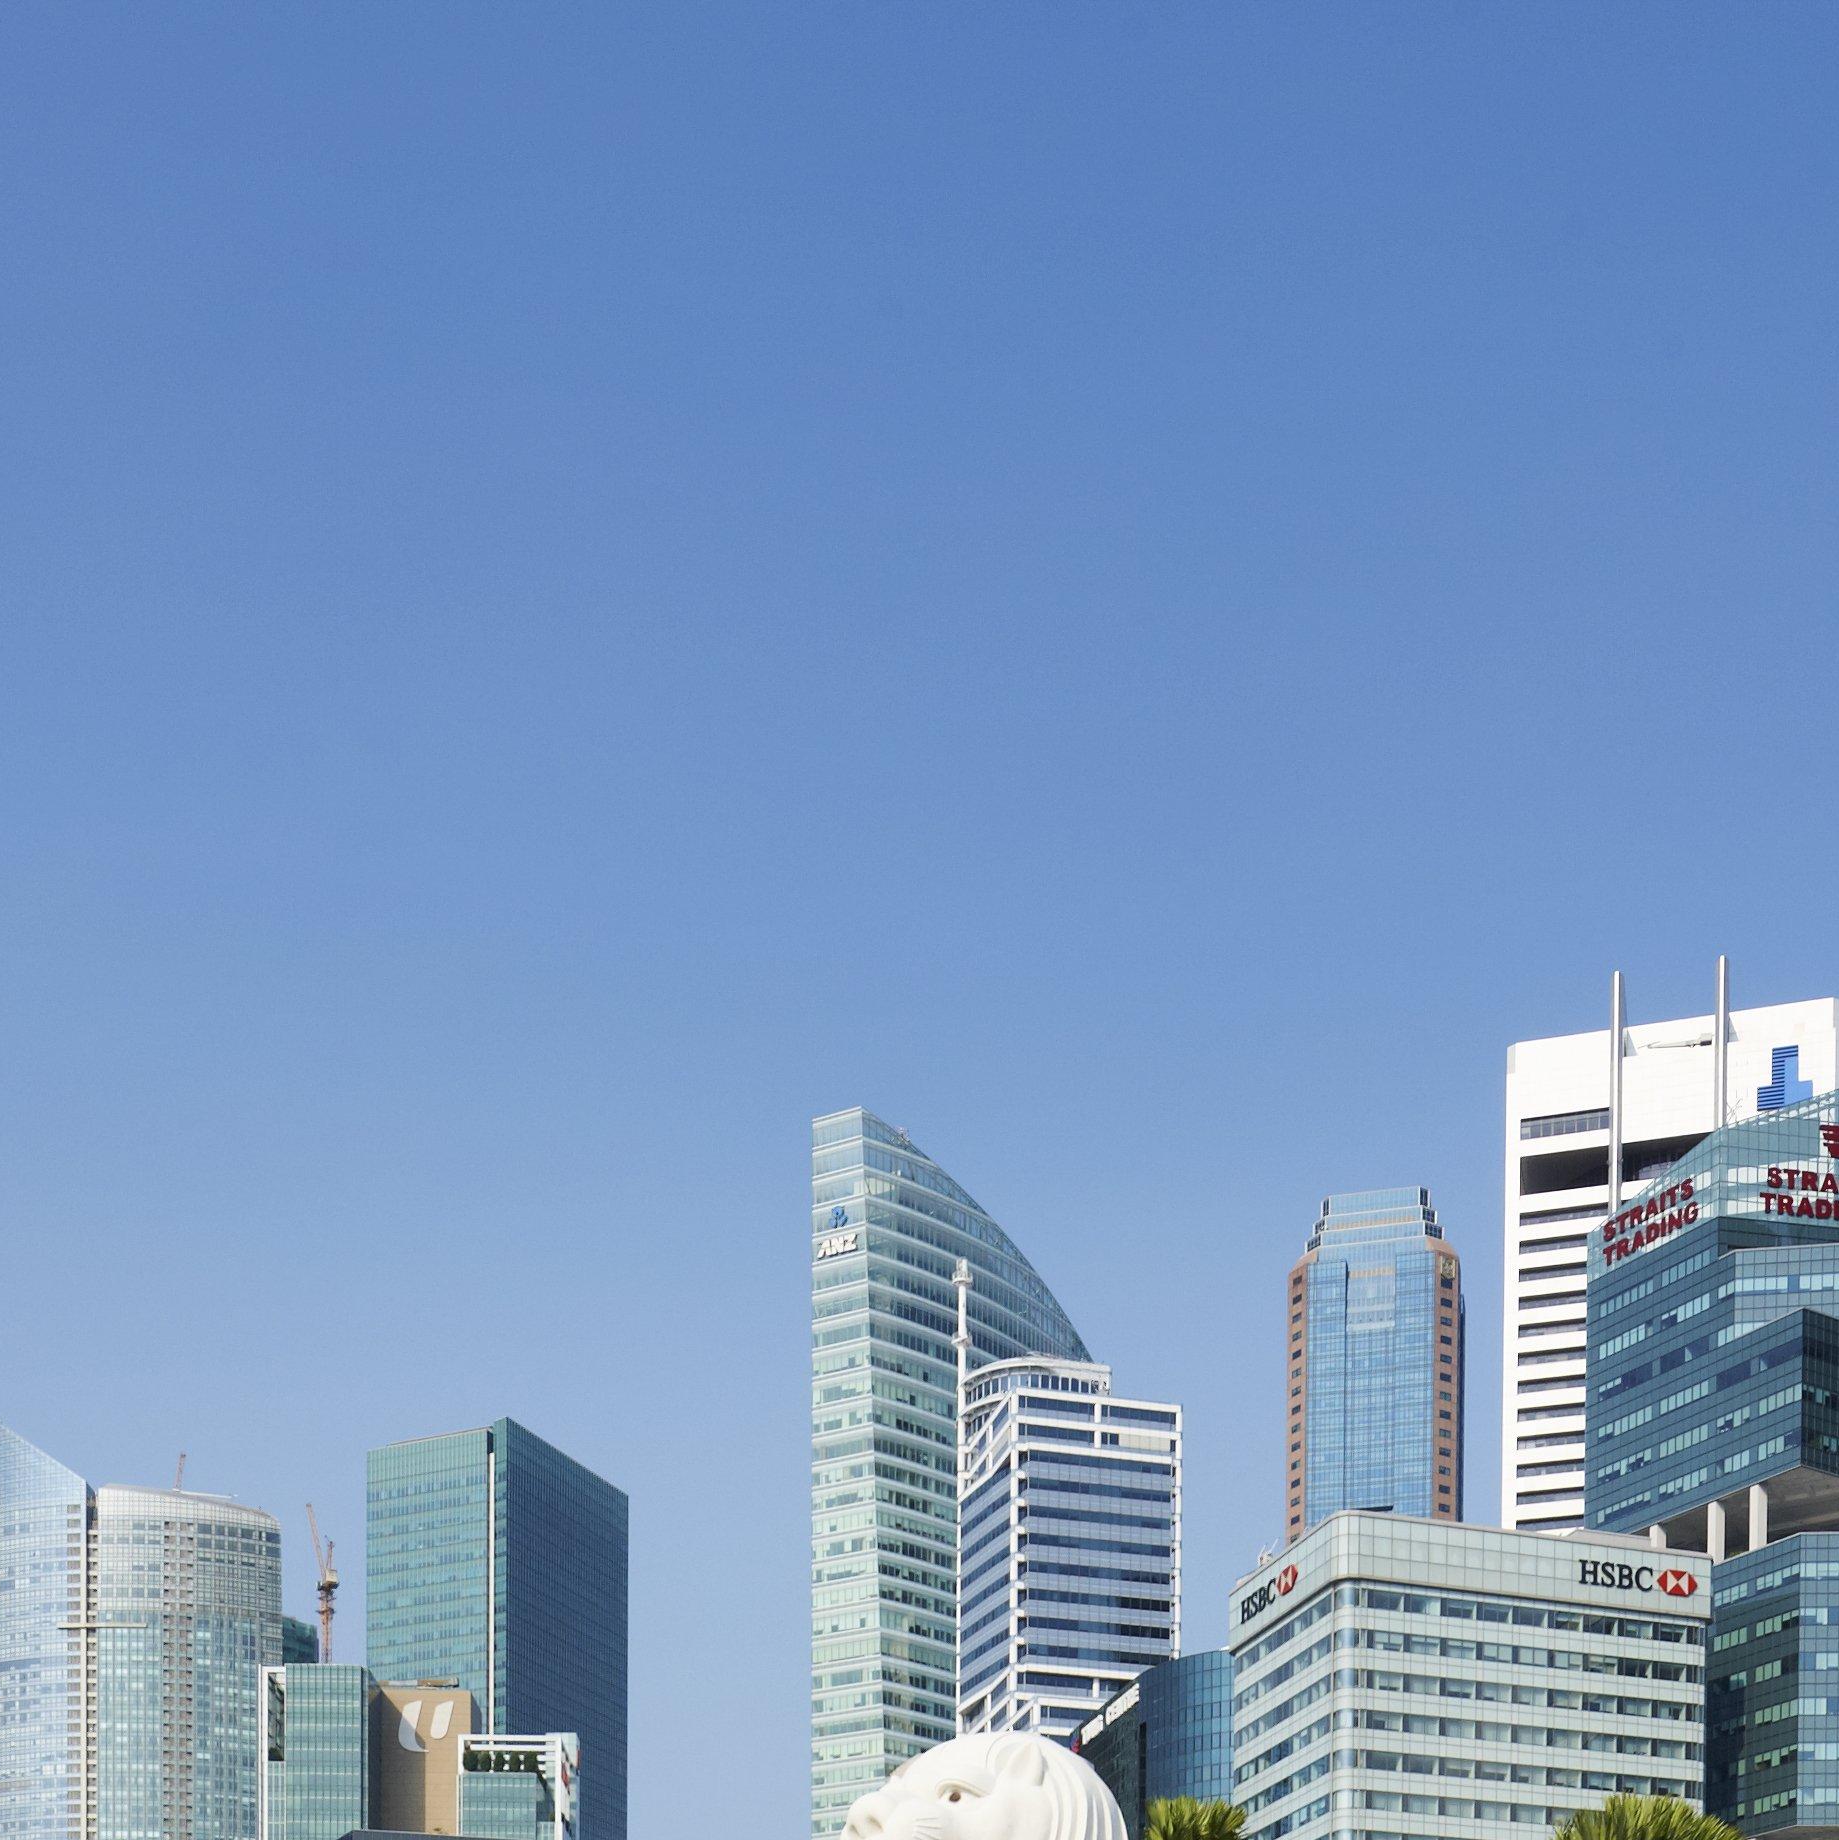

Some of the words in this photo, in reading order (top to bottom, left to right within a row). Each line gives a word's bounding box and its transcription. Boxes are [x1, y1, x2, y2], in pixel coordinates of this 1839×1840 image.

[1602, 1177, 1695, 1242] STRAITS
[816, 1232, 858, 1259] ANZ
[1602, 1201, 1699, 1266] TRADING
[1578, 1559, 1654, 1592] HSBC
[1240, 1578, 1276, 1625] HSBC
